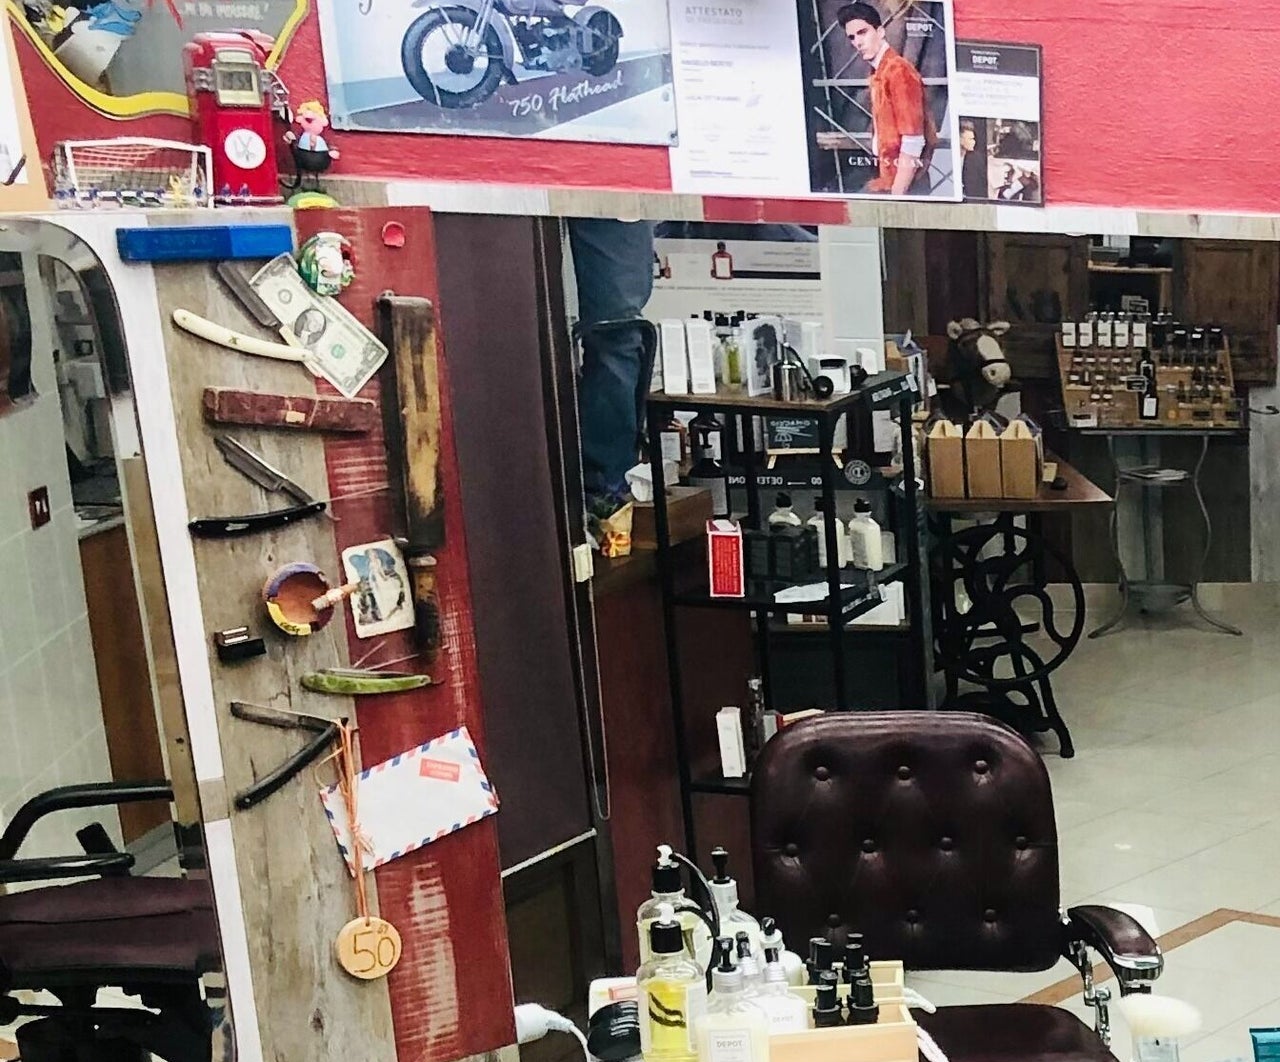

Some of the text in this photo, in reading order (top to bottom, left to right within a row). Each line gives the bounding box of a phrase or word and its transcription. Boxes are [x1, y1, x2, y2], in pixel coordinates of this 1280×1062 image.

[685, 6, 743, 17] ATTESTATO
[906, 22, 934, 32] DEPOT
[971, 55, 999, 65] DEPOT
[509, 71, 624, 117] 750 Flathead
[893, 157, 925, 168] CAN
[353, 930, 396, 973] 50
[716, 1039, 743, 1049] DEPOT
